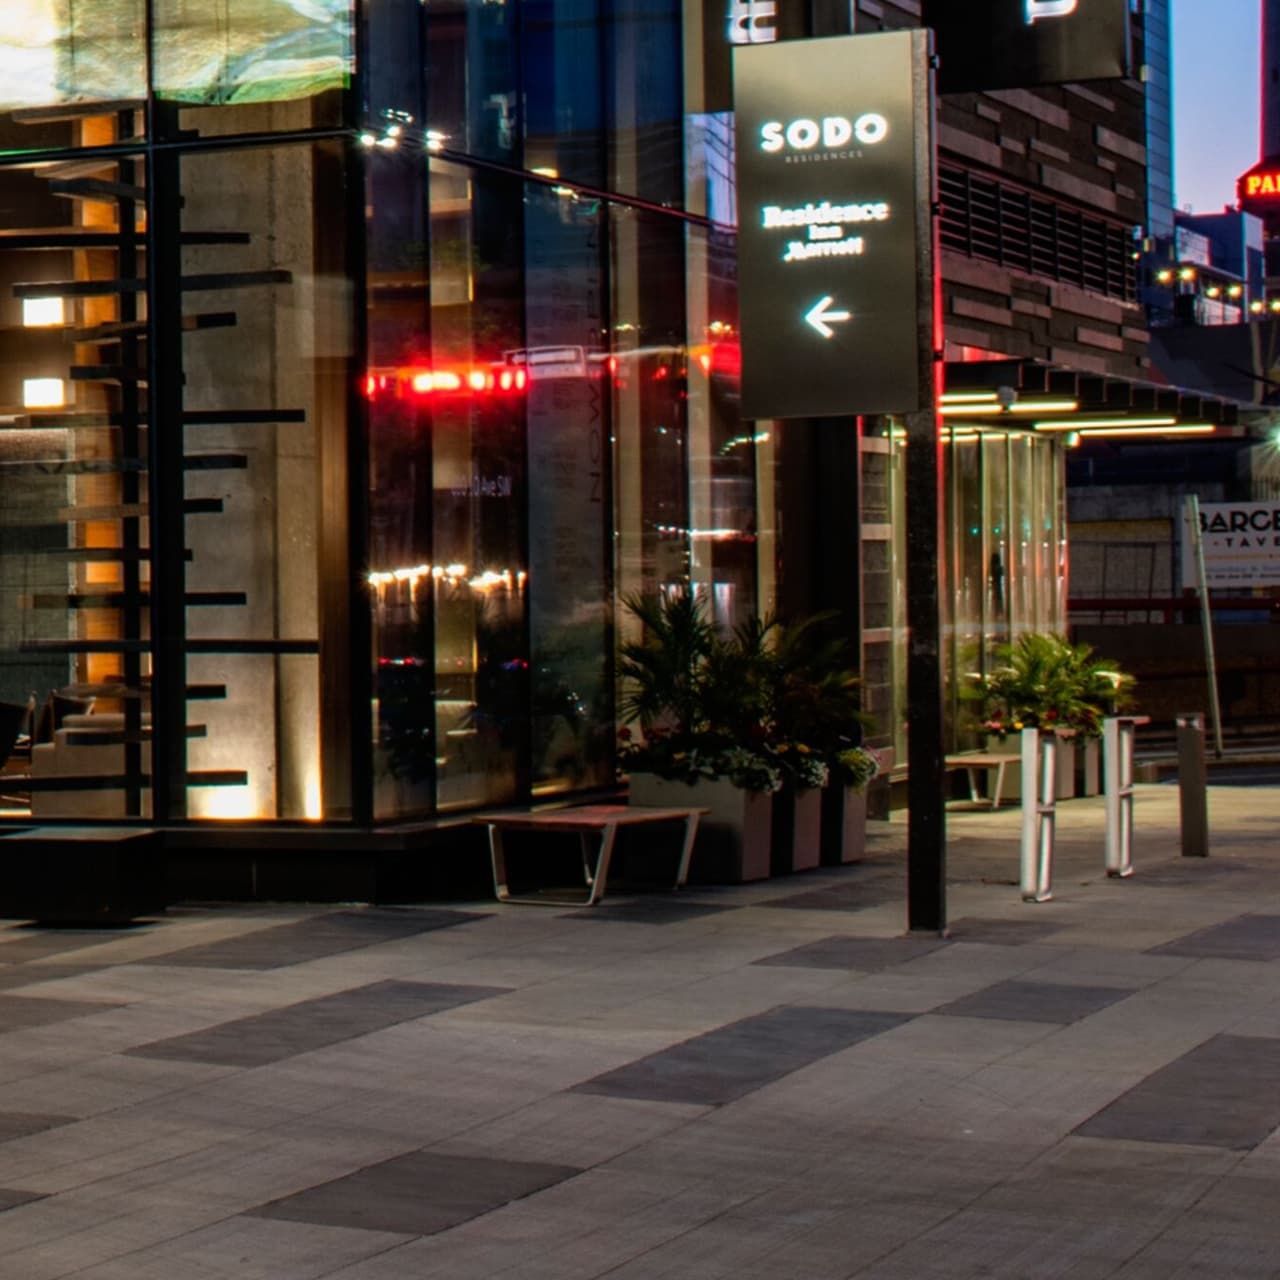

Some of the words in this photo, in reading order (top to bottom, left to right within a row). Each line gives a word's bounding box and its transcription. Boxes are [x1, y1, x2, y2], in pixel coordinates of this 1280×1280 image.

[759, 113, 889, 153] SODO
[785, 150, 864, 164] RESIDENCES
[1247, 175, 1280, 195] PA
[761, 201, 891, 229] Residence
